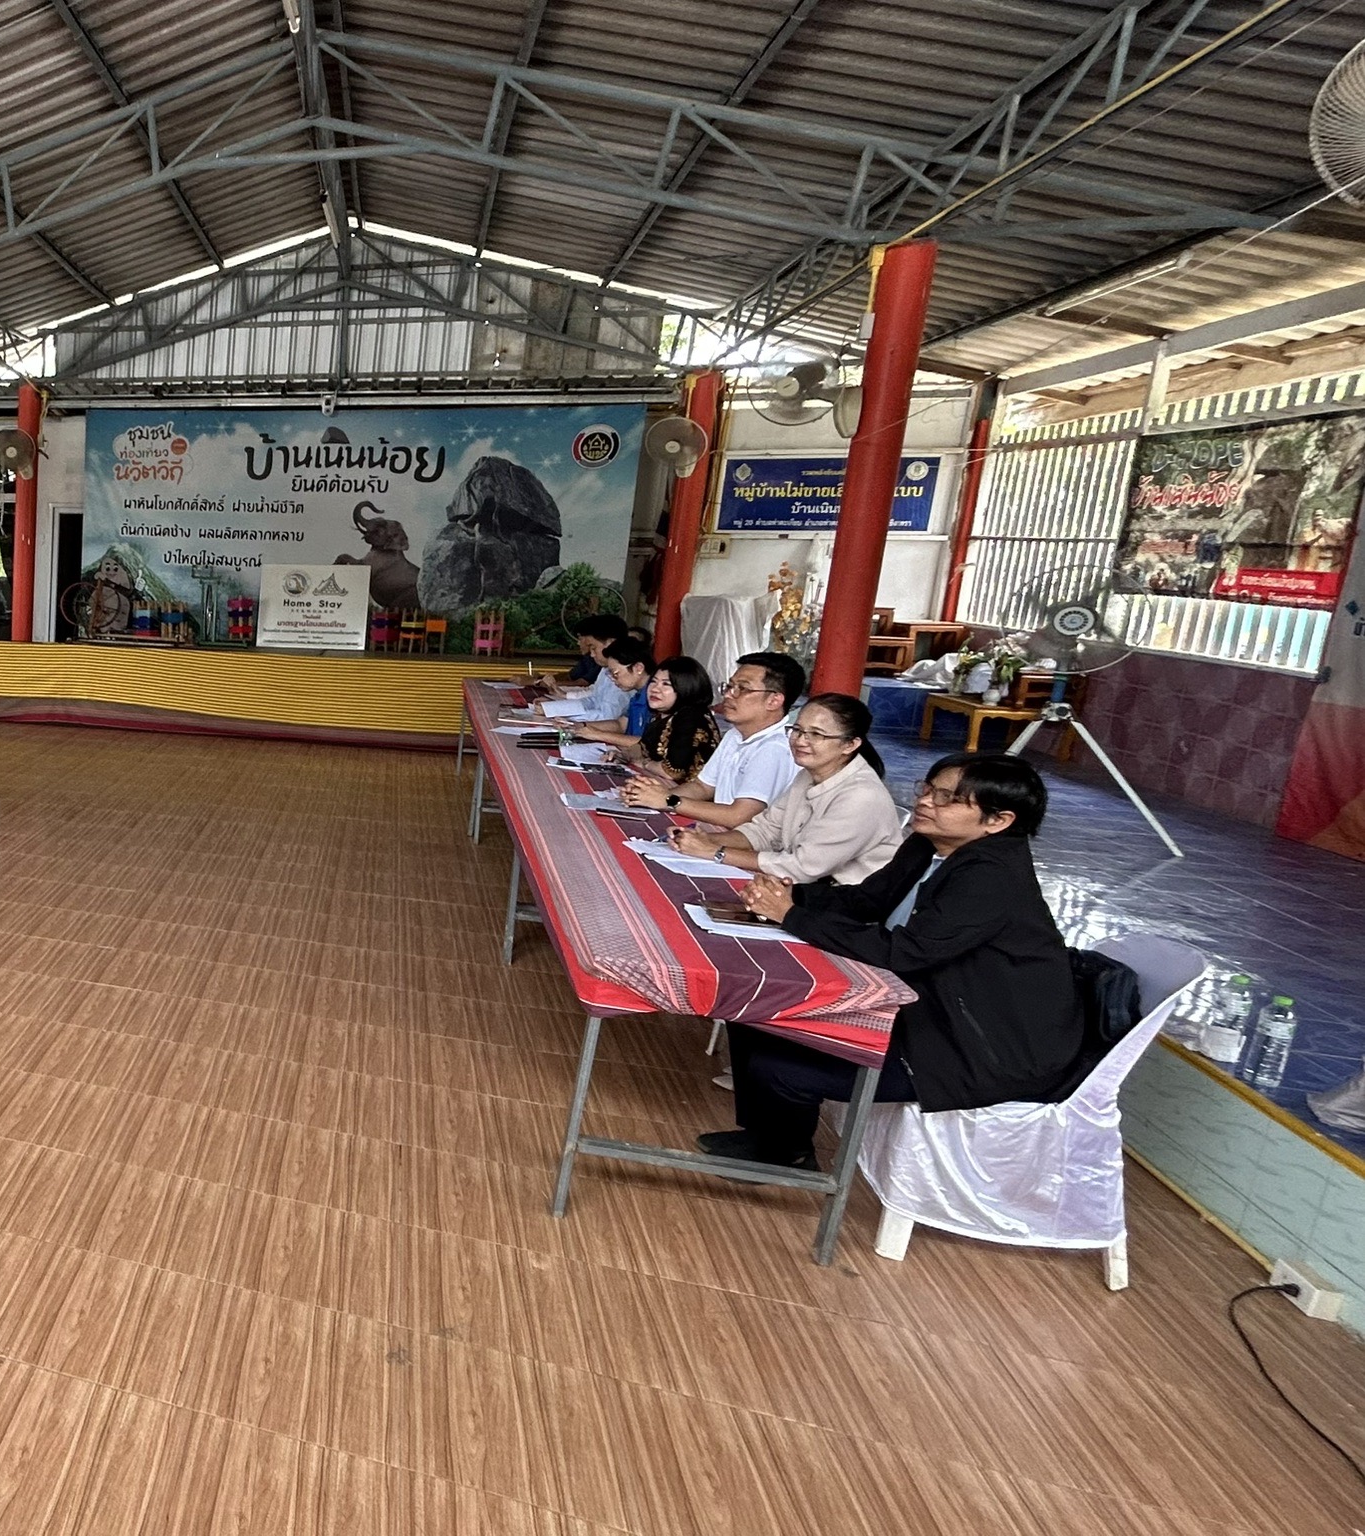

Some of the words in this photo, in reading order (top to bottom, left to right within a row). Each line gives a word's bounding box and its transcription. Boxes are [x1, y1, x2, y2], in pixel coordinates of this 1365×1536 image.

[127, 423, 172, 447] ชุมชน
[119, 442, 169, 459] ท่องเที่ยว
[115, 459, 184, 485] นวัตวิถี
[291, 474, 389, 493] ยินดีต้อนรับ
[123, 491, 225, 512] ผาหินโยกศักดิ์สิทธิ์
[232, 496, 305, 514] ฝายน้ำมีชีวิต
[120, 519, 191, 538] ถิ่นกำเนิดช้าง
[198, 526, 305, 542] ผลผลิตหลากหลาย
[283, 599, 312, 608] Home
[318, 599, 343, 608] Stay
